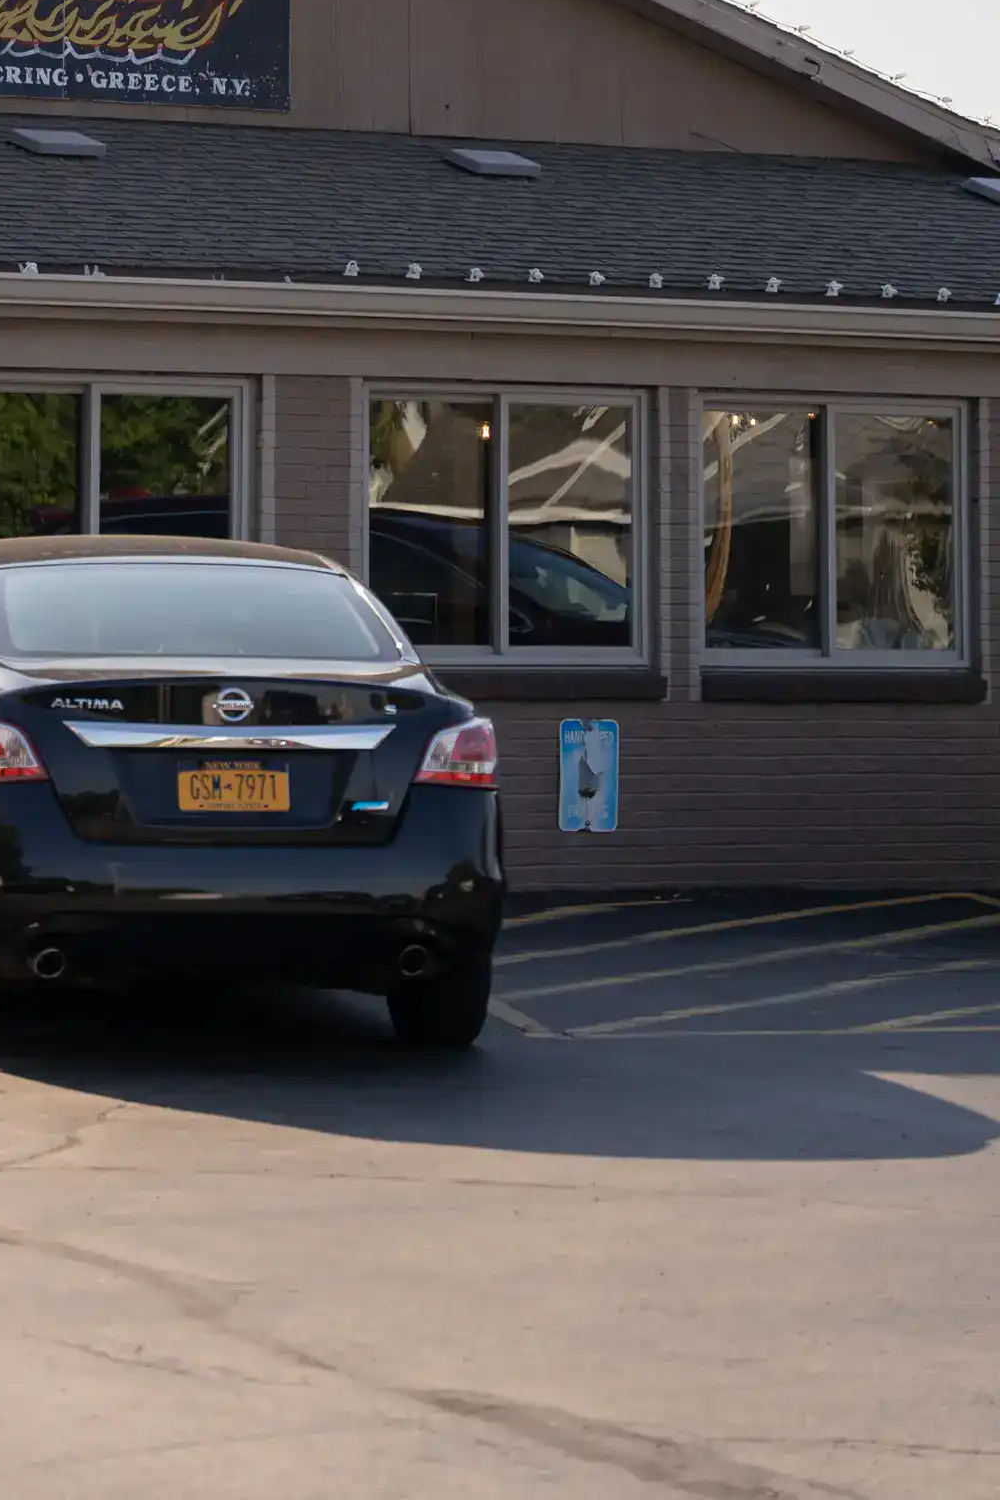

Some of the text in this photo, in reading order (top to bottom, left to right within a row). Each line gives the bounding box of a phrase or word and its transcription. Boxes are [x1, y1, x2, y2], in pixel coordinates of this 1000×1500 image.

[91, 70, 200, 95] GREECE,
[51, 697, 125, 711] ALTIMA
[217, 702, 252, 710] NISSAN
